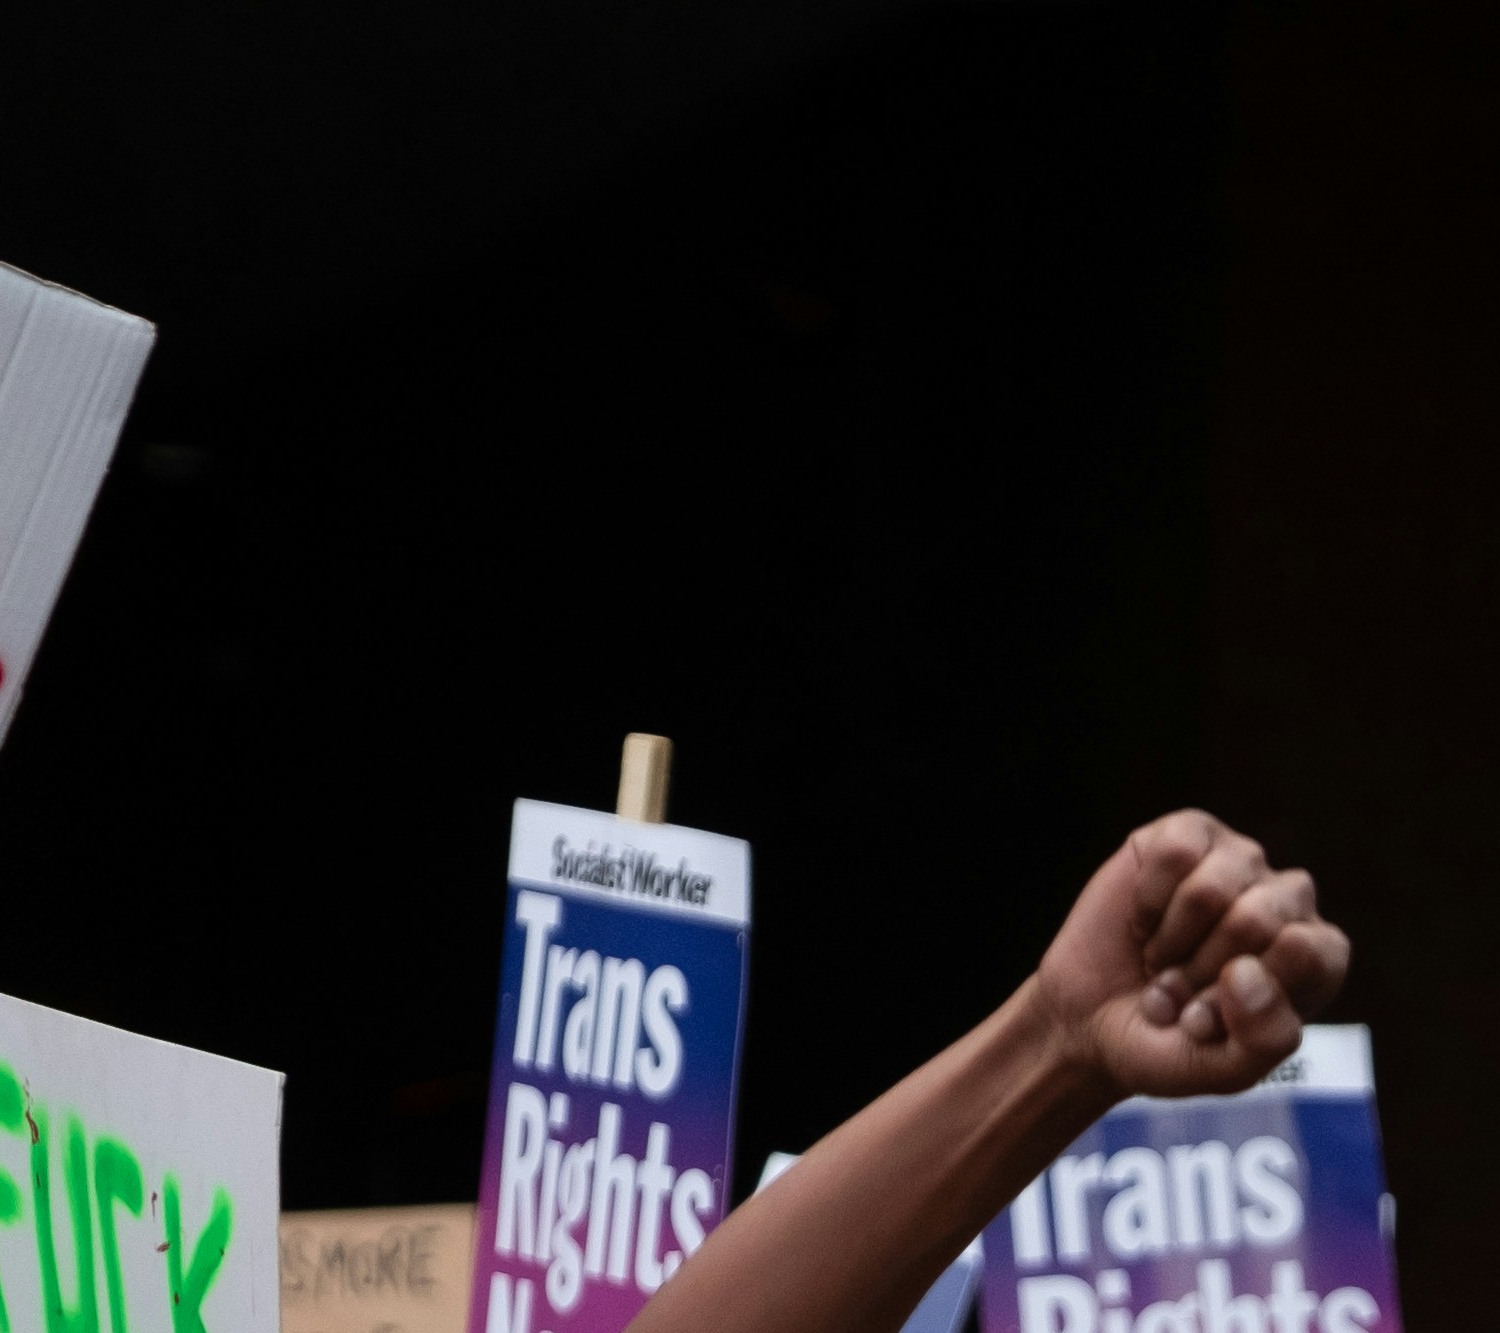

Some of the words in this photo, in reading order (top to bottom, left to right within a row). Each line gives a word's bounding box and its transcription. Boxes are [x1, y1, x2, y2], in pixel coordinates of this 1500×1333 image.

[552, 834, 627, 895] Socialist
[627, 842, 716, 908] Worker
[512, 891, 689, 1098] Trans
[495, 1082, 714, 1315] Rights
